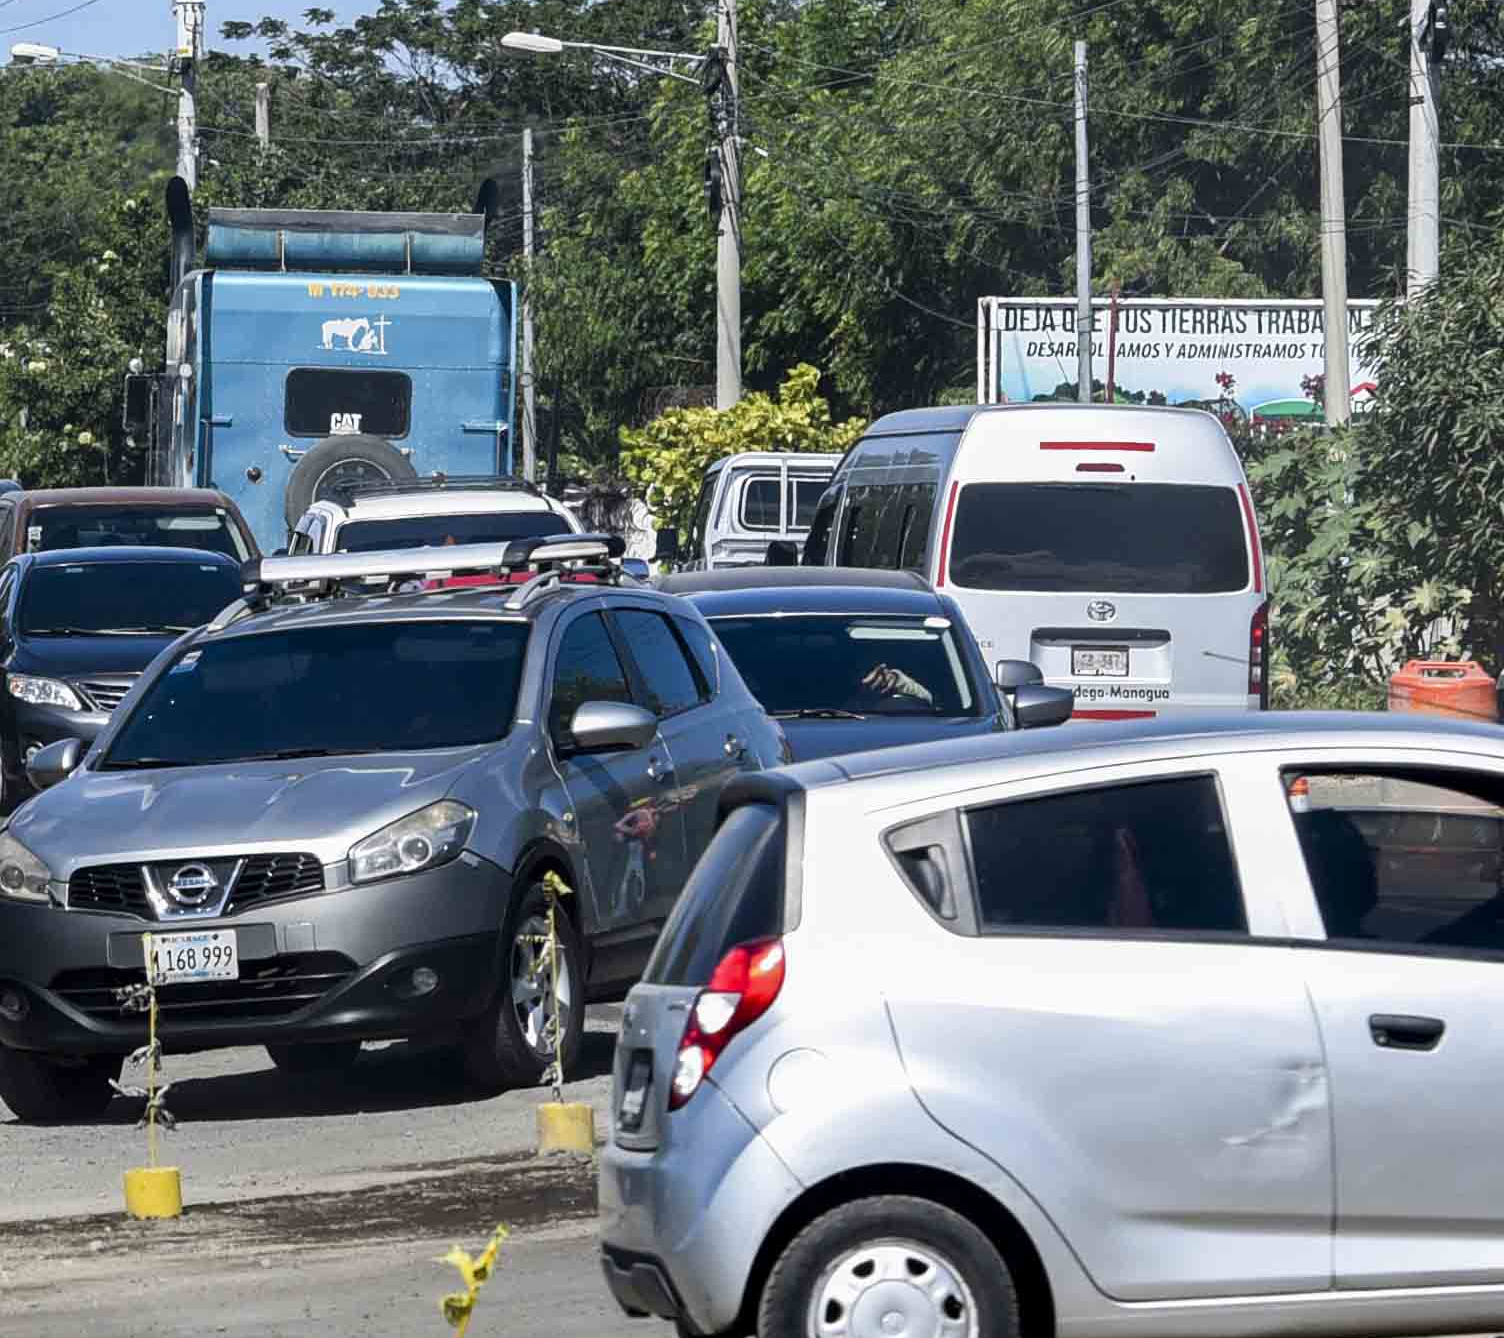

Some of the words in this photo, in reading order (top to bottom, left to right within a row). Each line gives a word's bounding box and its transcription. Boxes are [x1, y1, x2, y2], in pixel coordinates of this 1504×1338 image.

[1004, 308, 1055, 332] DEJA
[1062, 308, 1103, 333] QE
[1157, 308, 1247, 334] TIERRAS
[1164, 343, 1174, 358] Y
[1176, 342, 1306, 359] ADMINISTRAMOS
[330, 412, 362, 430] CAT
[166, 948, 197, 972] 168
[202, 945, 233, 968] 999
